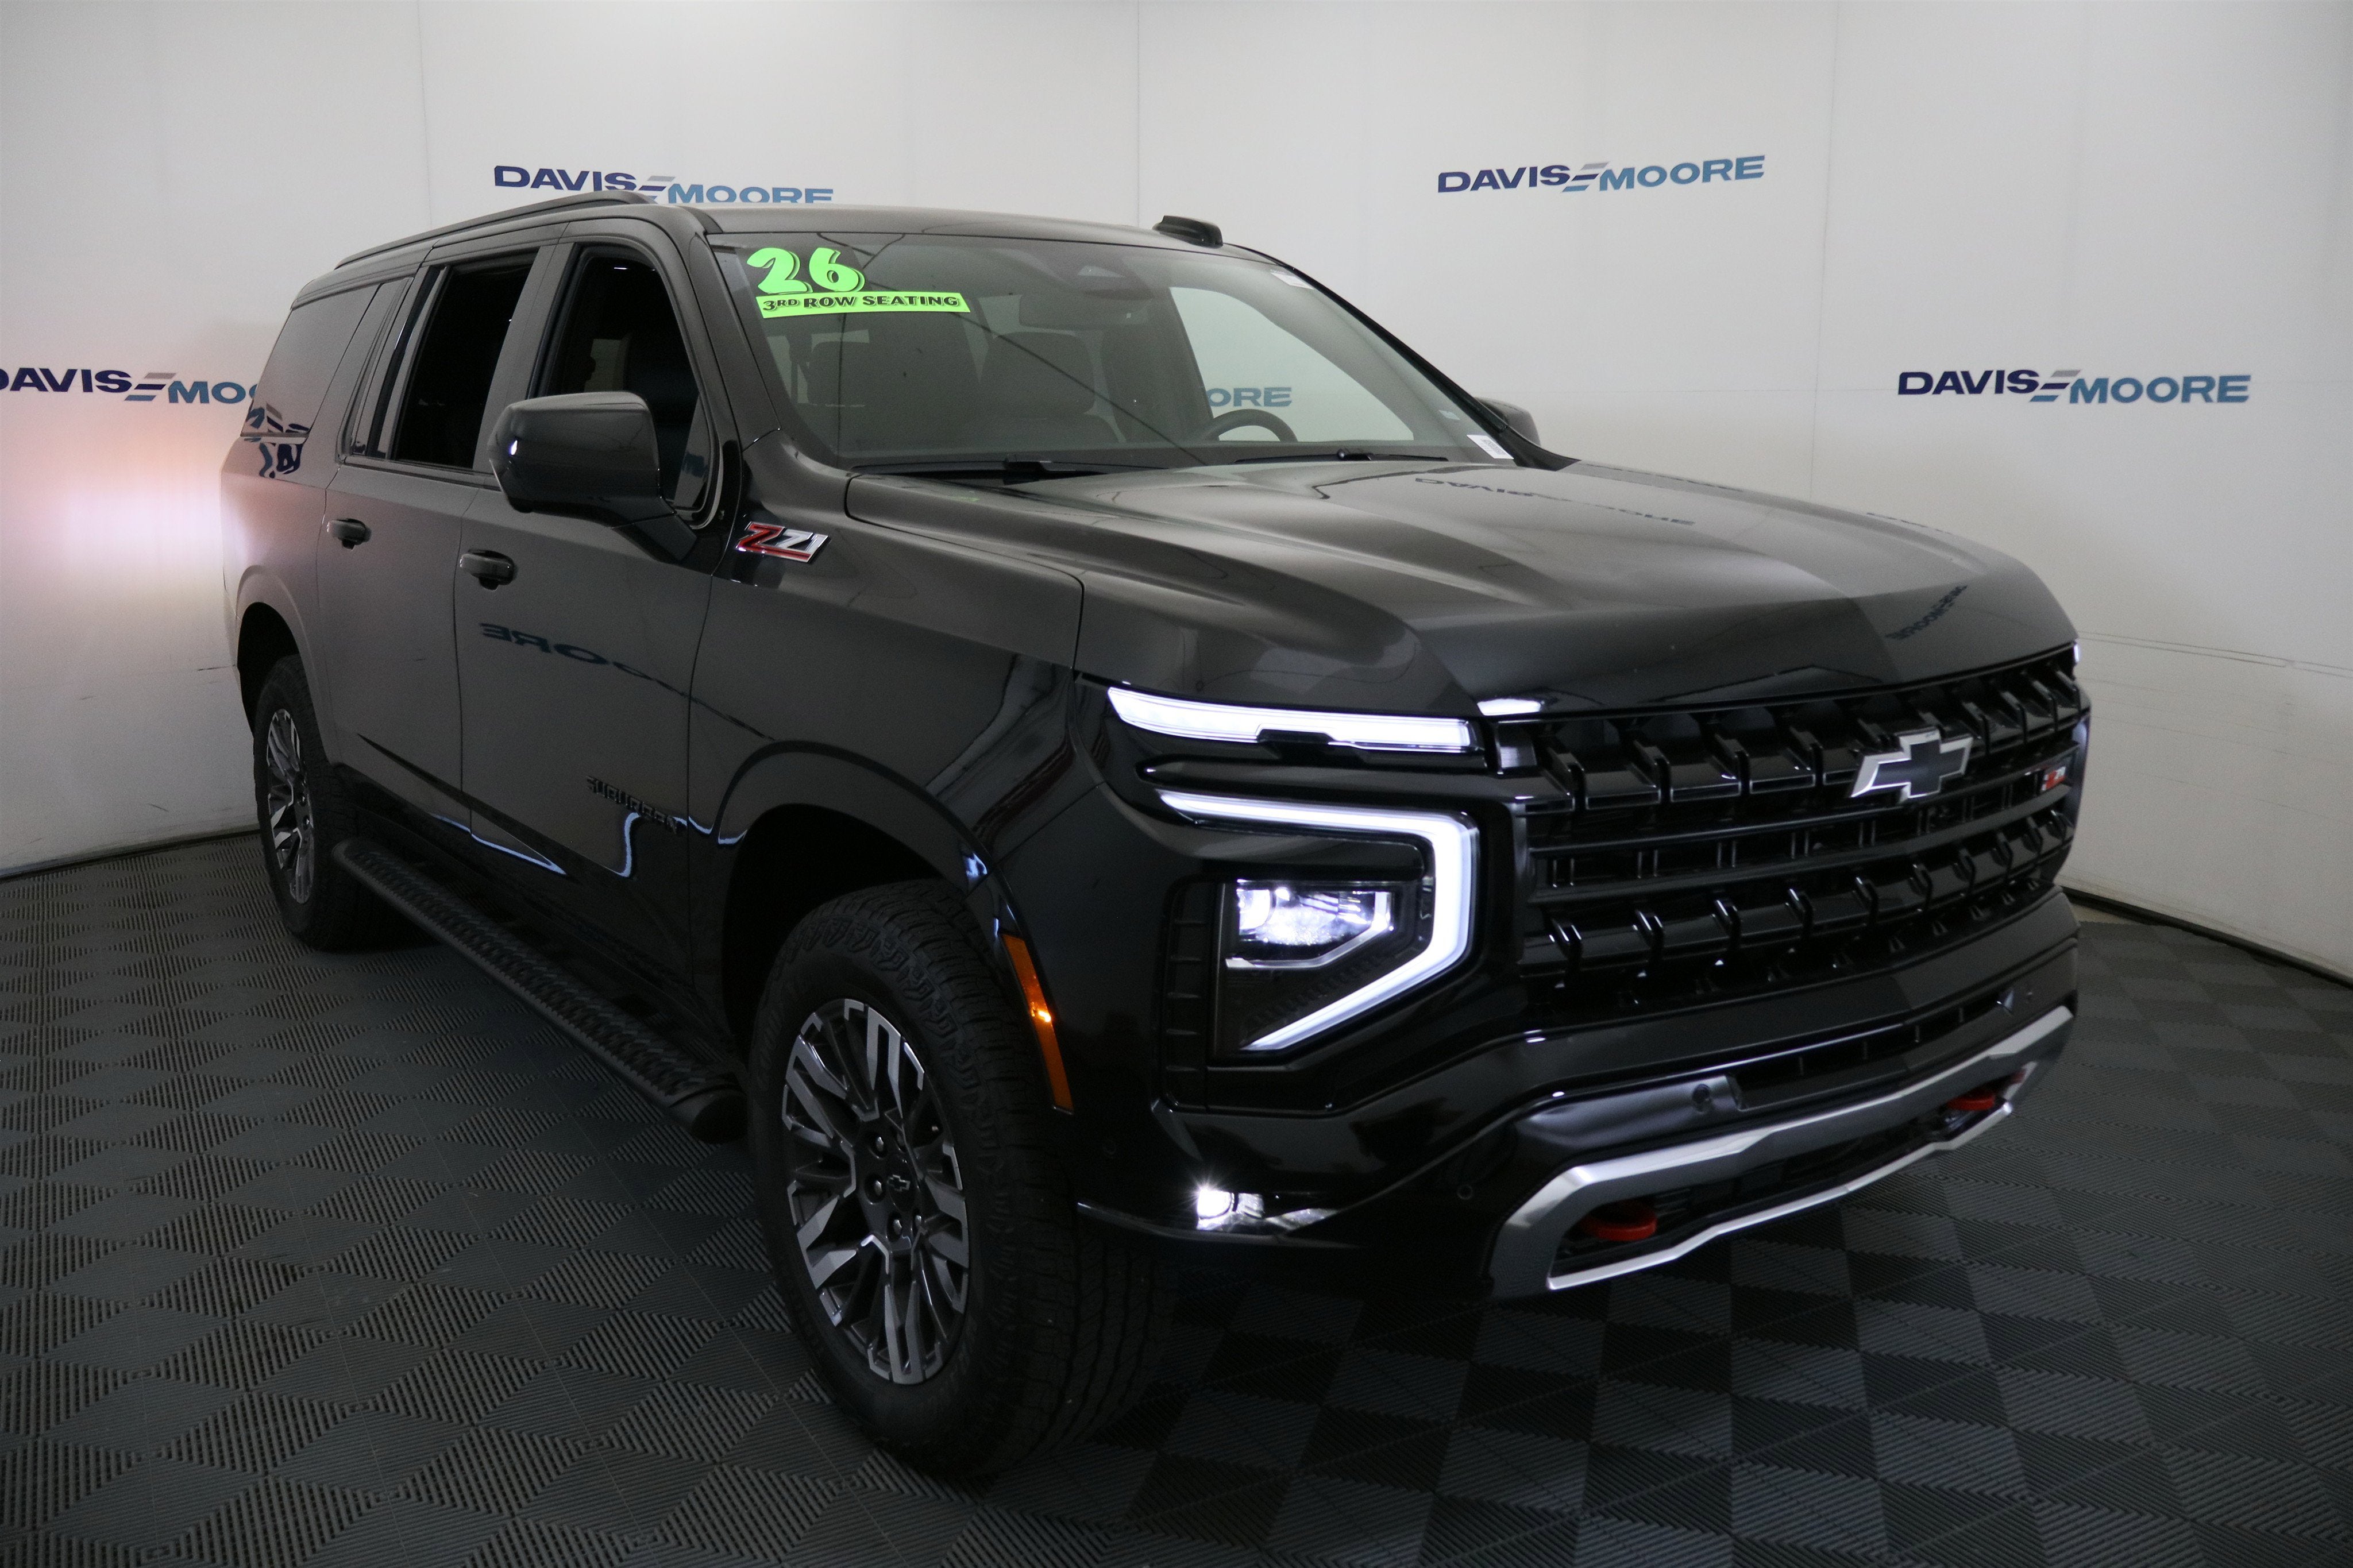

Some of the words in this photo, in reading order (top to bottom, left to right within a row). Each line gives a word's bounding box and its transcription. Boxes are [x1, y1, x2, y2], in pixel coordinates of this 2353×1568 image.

[494, 165, 637, 191] DAVIS
[668, 183, 834, 203] MOORE
[1438, 164, 1570, 193] DAVIS
[1599, 155, 1765, 191] MOORE
[747, 247, 866, 295] 26
[762, 299, 799, 312] 3RD
[804, 297, 856, 308] ROW
[862, 295, 959, 307] SEATING
[0, 368, 133, 393] AVIS
[168, 380, 257, 404] MO
[1898, 369, 2040, 395] DAVIS
[2069, 374, 2251, 403] MOORE
